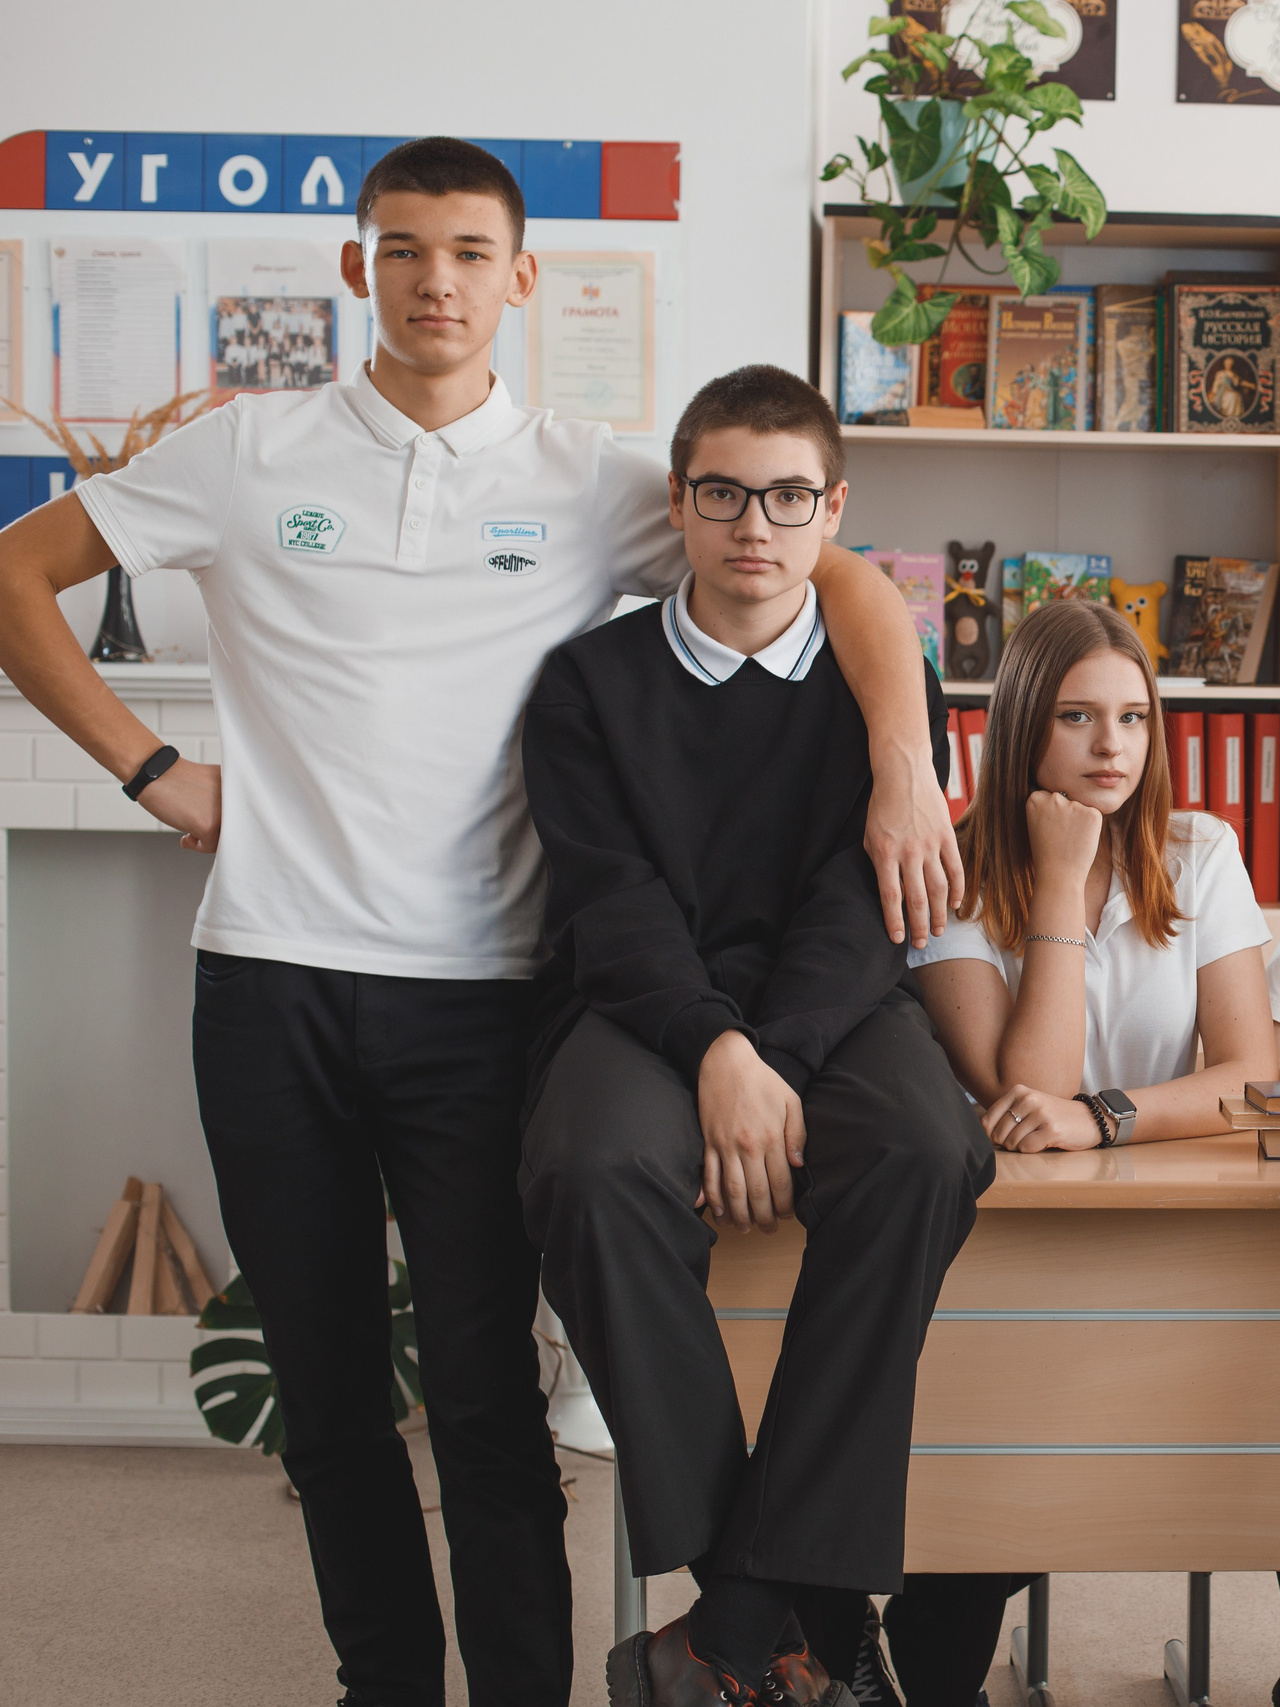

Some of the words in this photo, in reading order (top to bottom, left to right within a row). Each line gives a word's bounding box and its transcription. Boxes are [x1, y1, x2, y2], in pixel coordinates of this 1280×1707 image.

[68, 152, 345, 207] УГОЛ
[1204, 321, 1260, 333] РУССКАЯ
[1202, 334, 1262, 345] ИСТОРИЯ
[286, 514, 318, 528] Sport
[489, 526, 538, 537] Sportline
